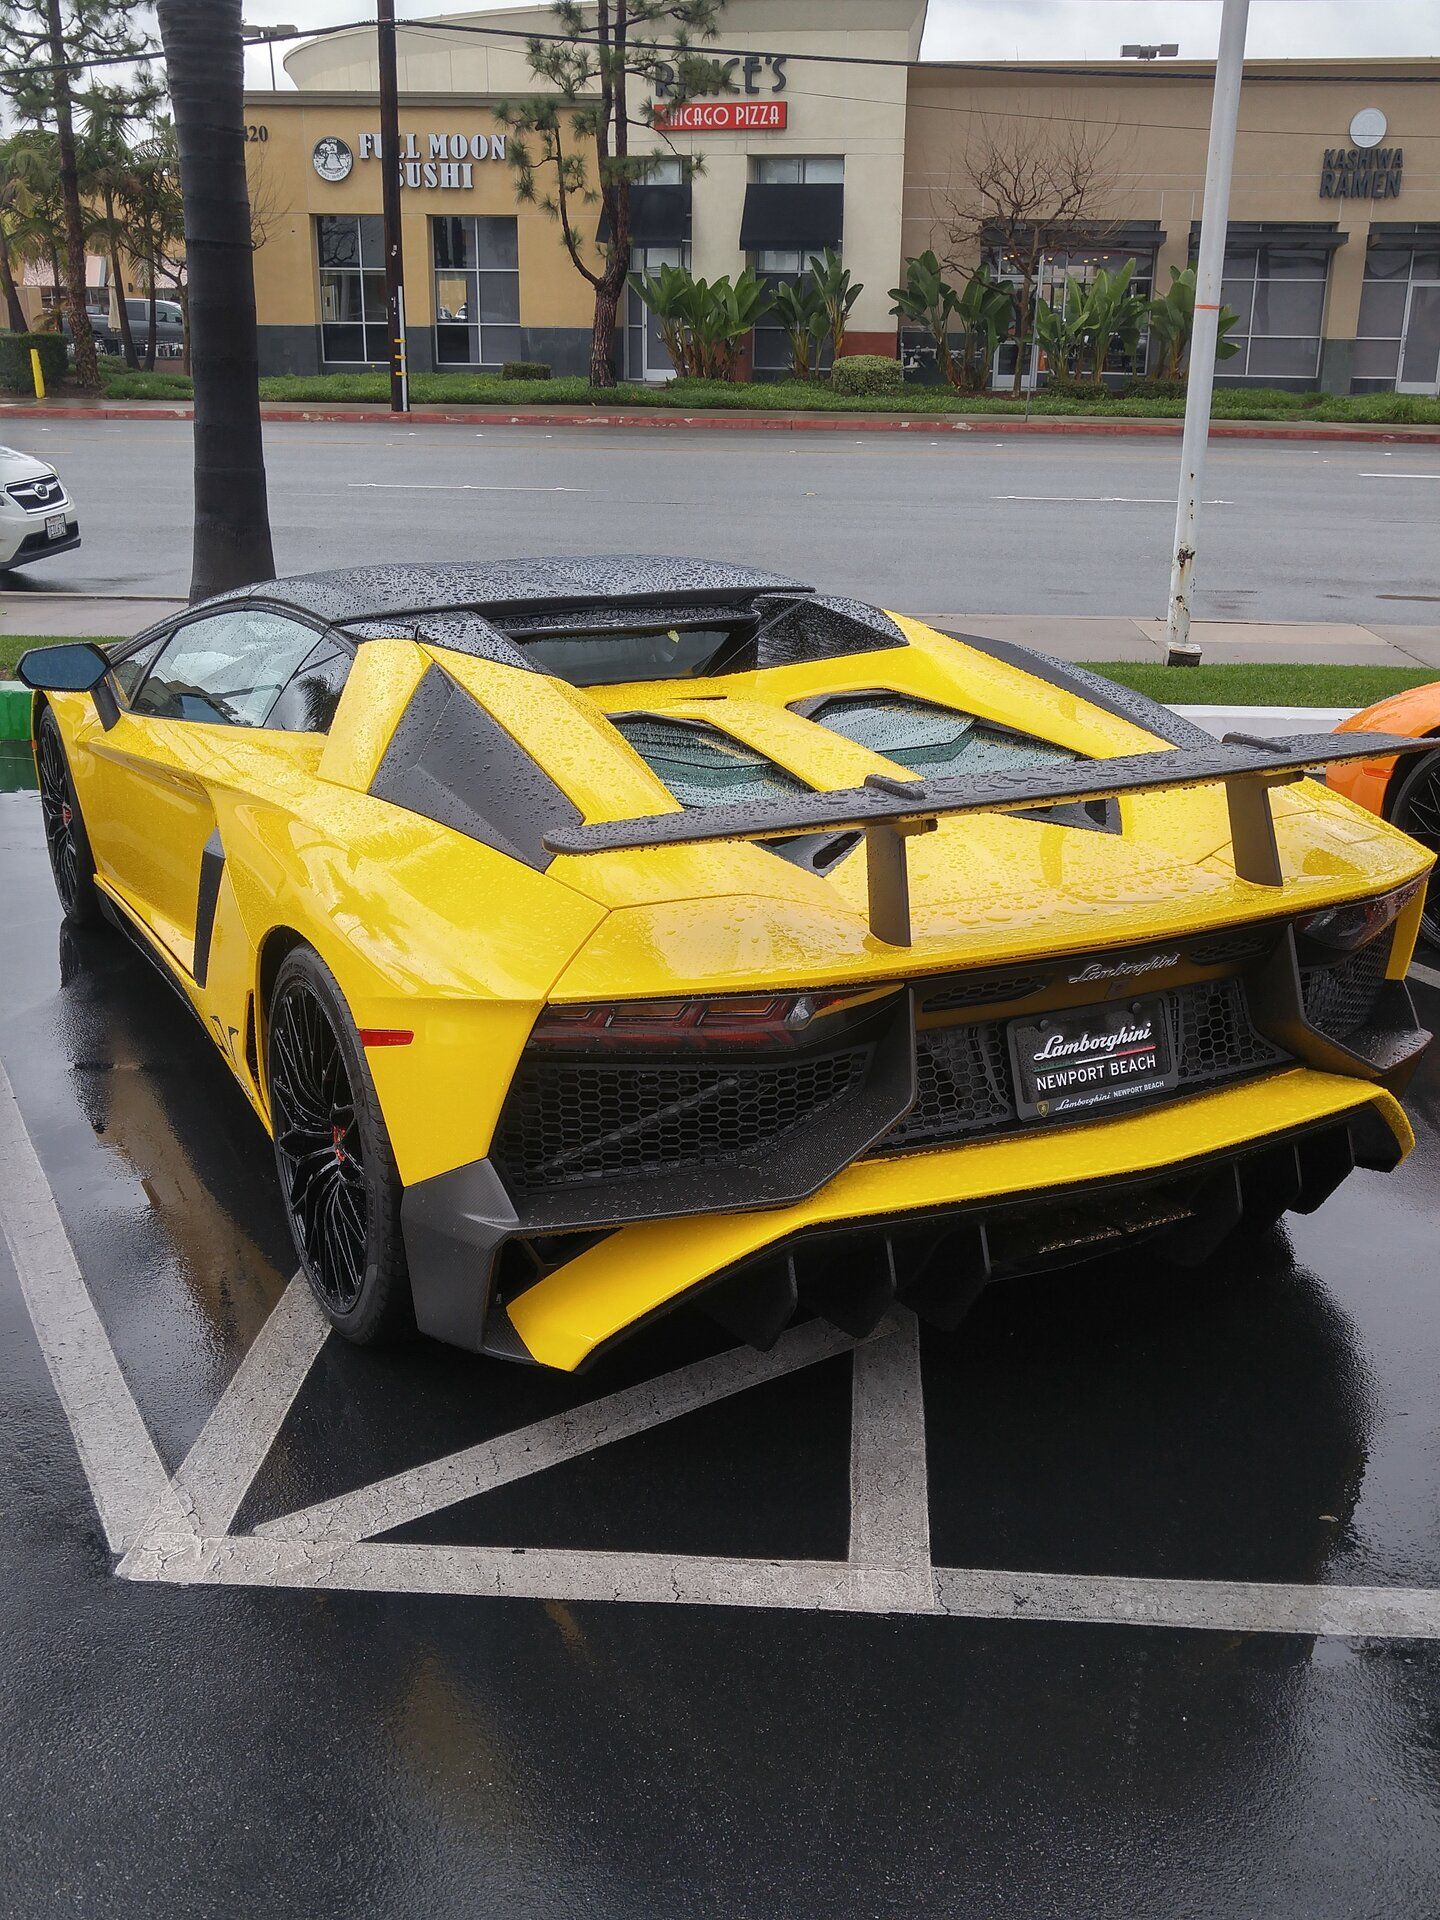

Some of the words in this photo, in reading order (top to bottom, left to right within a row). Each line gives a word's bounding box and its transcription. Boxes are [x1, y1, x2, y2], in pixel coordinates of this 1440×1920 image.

[661, 106, 729, 126] HICAGO
[735, 105, 780, 126] PIZZA
[358, 133, 421, 160] FUL
[428, 133, 506, 160] MOON
[1323, 148, 1404, 170] KASHIWA
[1319, 170, 1403, 199] RAMEN
[1067, 952, 1181, 984] Lamborghini
[1033, 1022, 1152, 1061] Lamborghini
[1036, 1065, 1105, 1092] NEWPORT
[1110, 1054, 1157, 1077] BEACH
[1055, 1092, 1112, 1112] Lamborghini
[1113, 1085, 1143, 1099] NEWPORT
[1144, 1080, 1165, 1092] BEACH
